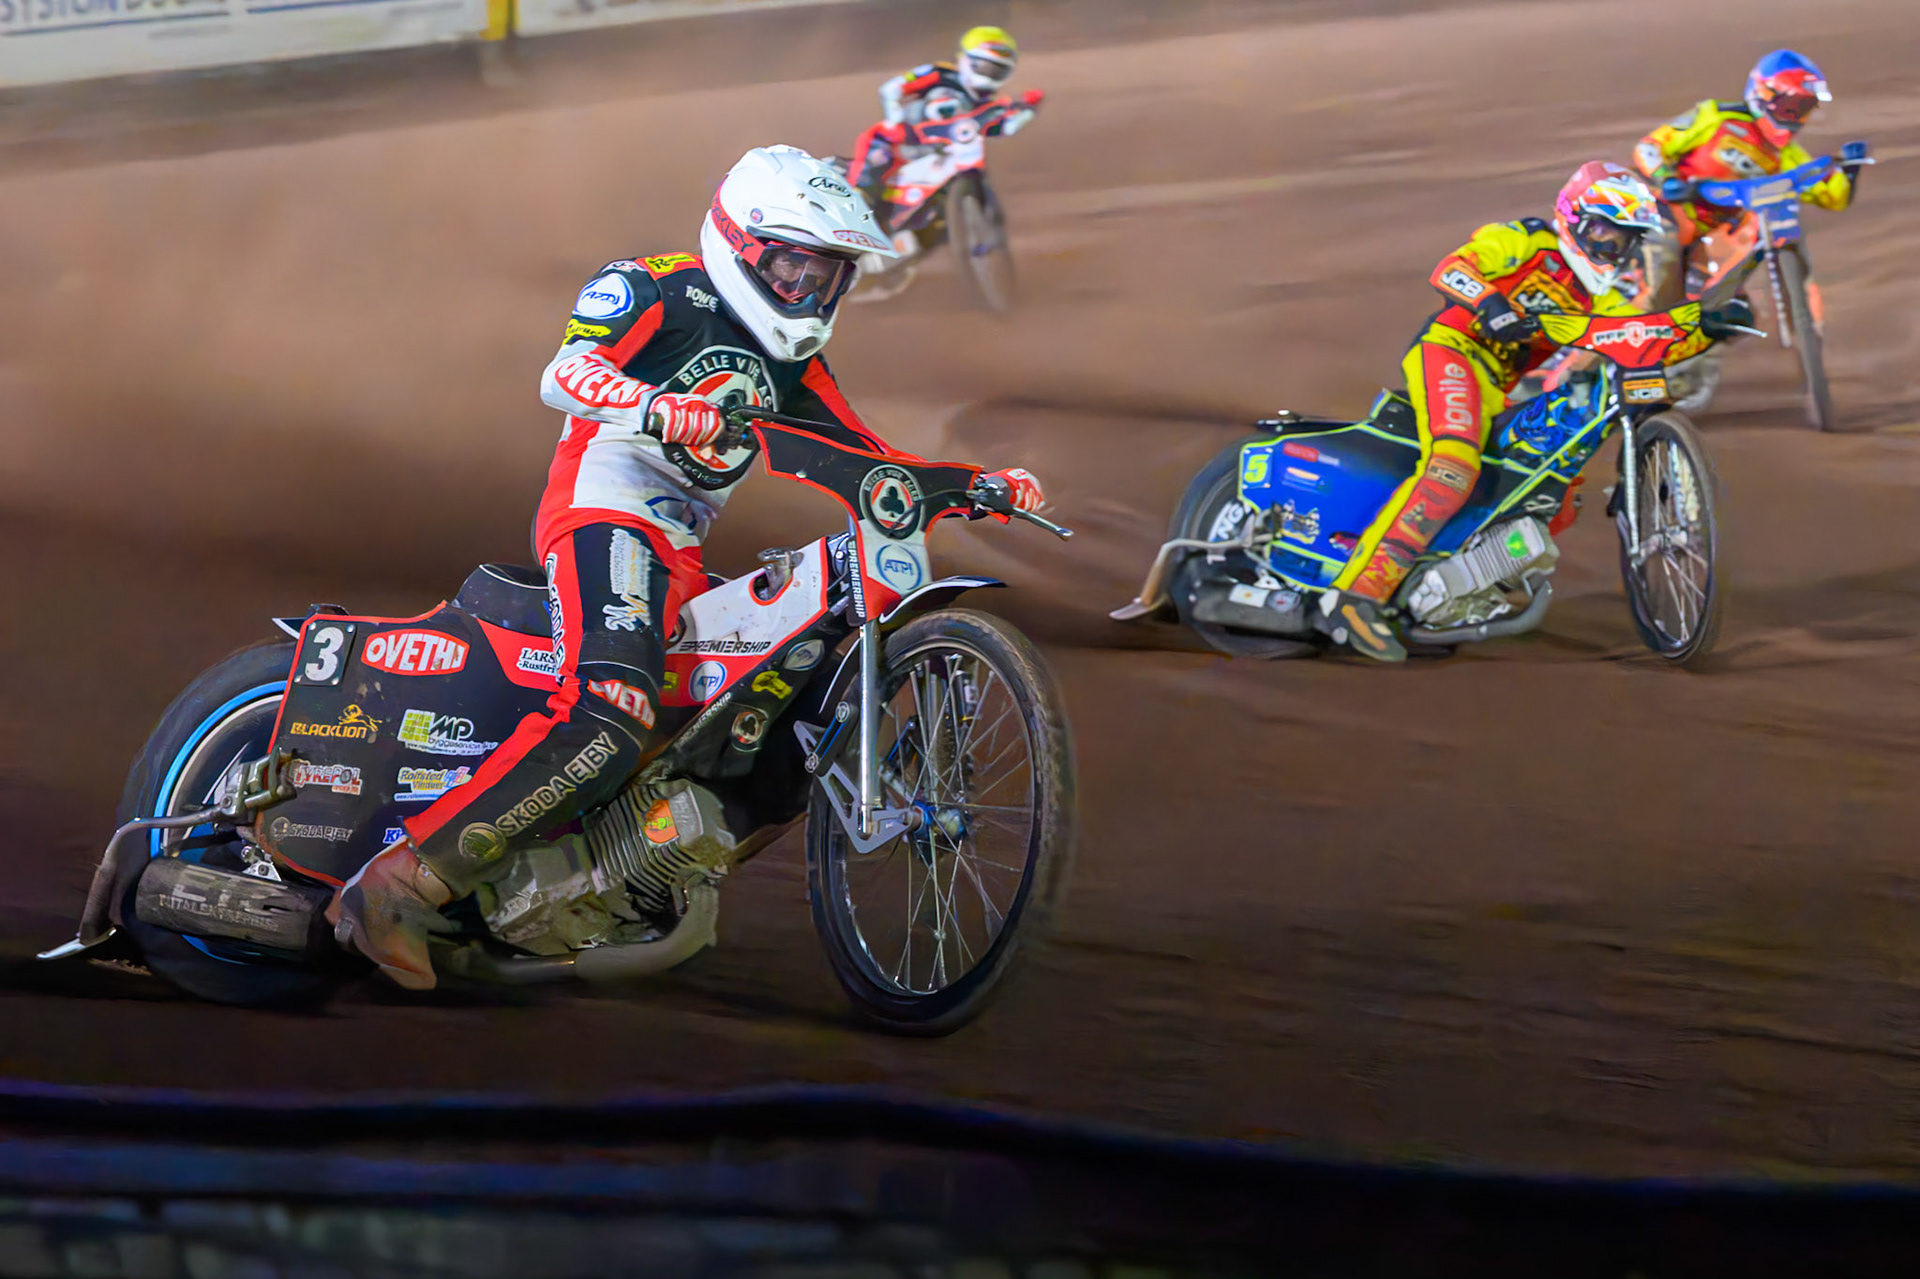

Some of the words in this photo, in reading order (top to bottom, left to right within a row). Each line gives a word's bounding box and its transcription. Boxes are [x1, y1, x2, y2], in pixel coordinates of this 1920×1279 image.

[685, 285, 719, 308] ROWE
[1441, 269, 1486, 299] JCB
[678, 355, 730, 386] BELLE
[1244, 453, 1270, 483] 5
[848, 540, 867, 619] PREMIERSHIP
[304, 626, 345, 682] 3
[680, 640, 772, 654] PREMIERSHIP
